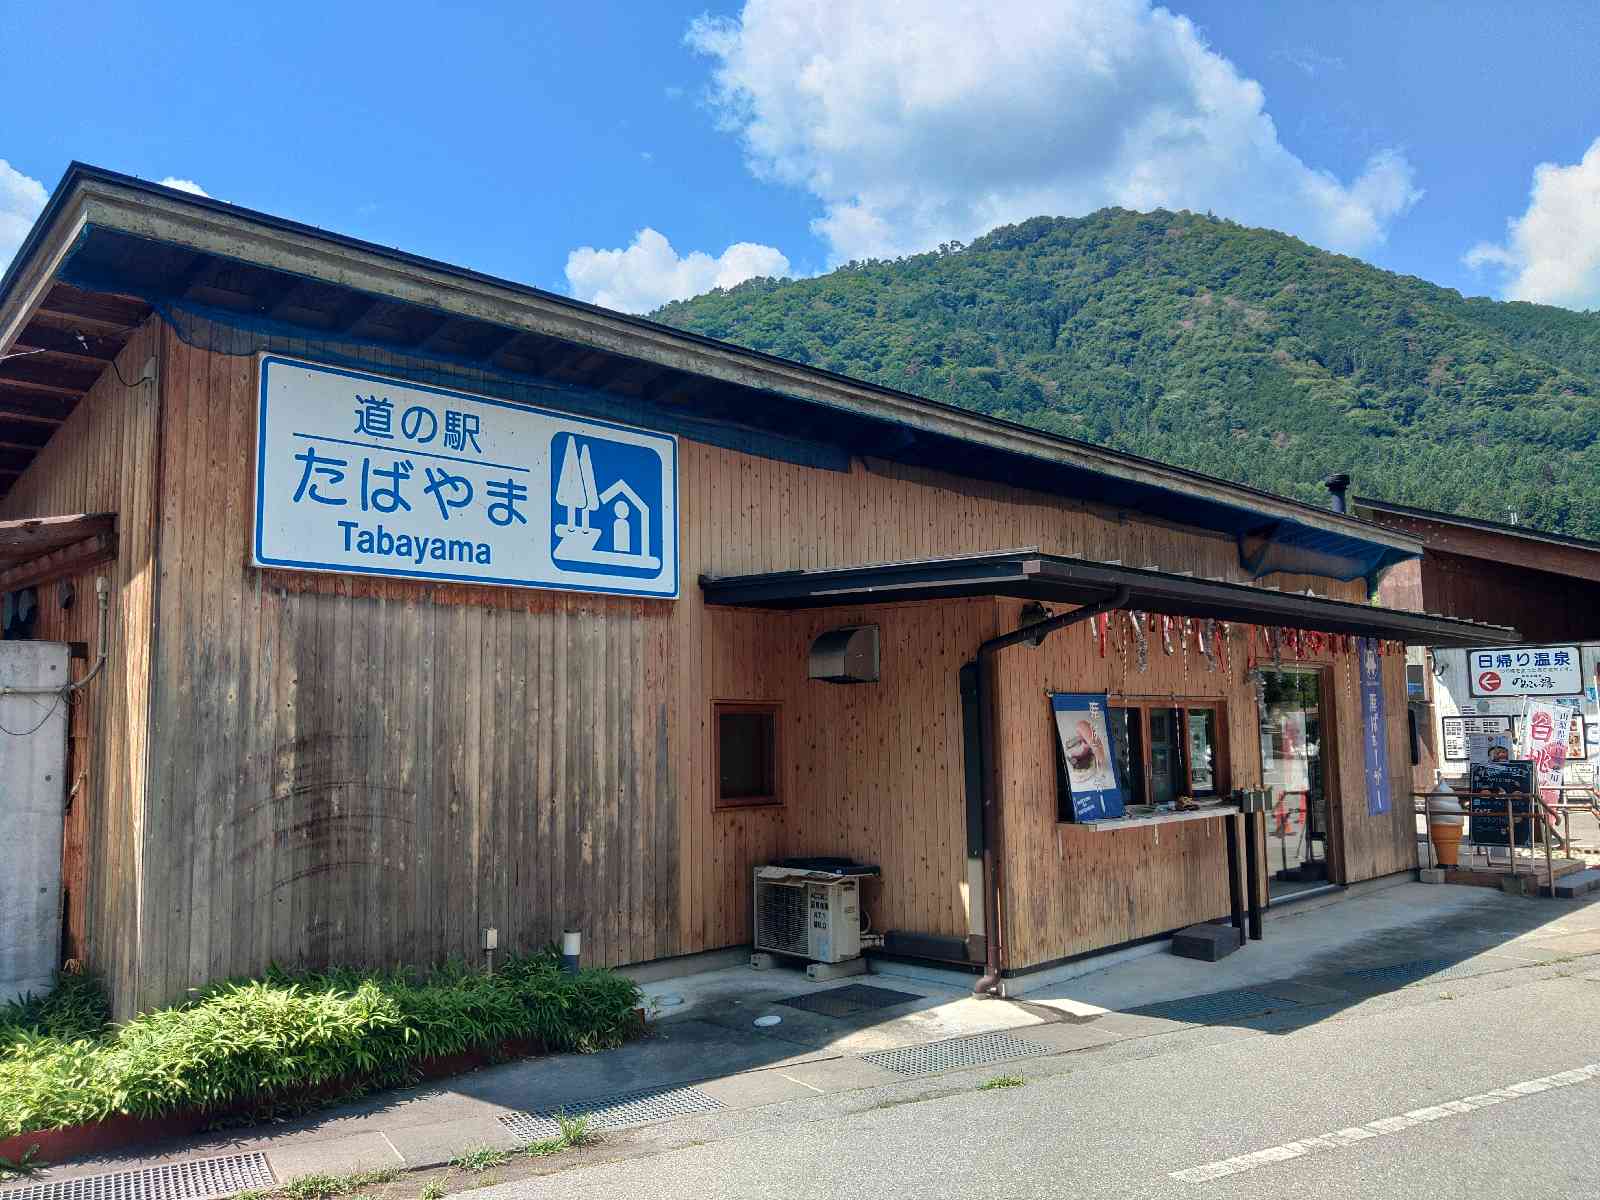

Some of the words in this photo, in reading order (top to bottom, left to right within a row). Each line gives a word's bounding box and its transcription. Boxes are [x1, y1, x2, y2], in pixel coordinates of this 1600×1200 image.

[354, 394, 482, 454] 道の駅
[293, 447, 528, 528] たばやま
[338, 521, 491, 565] Tabayama
[1478, 651, 1570, 668] 日帰り温泉
